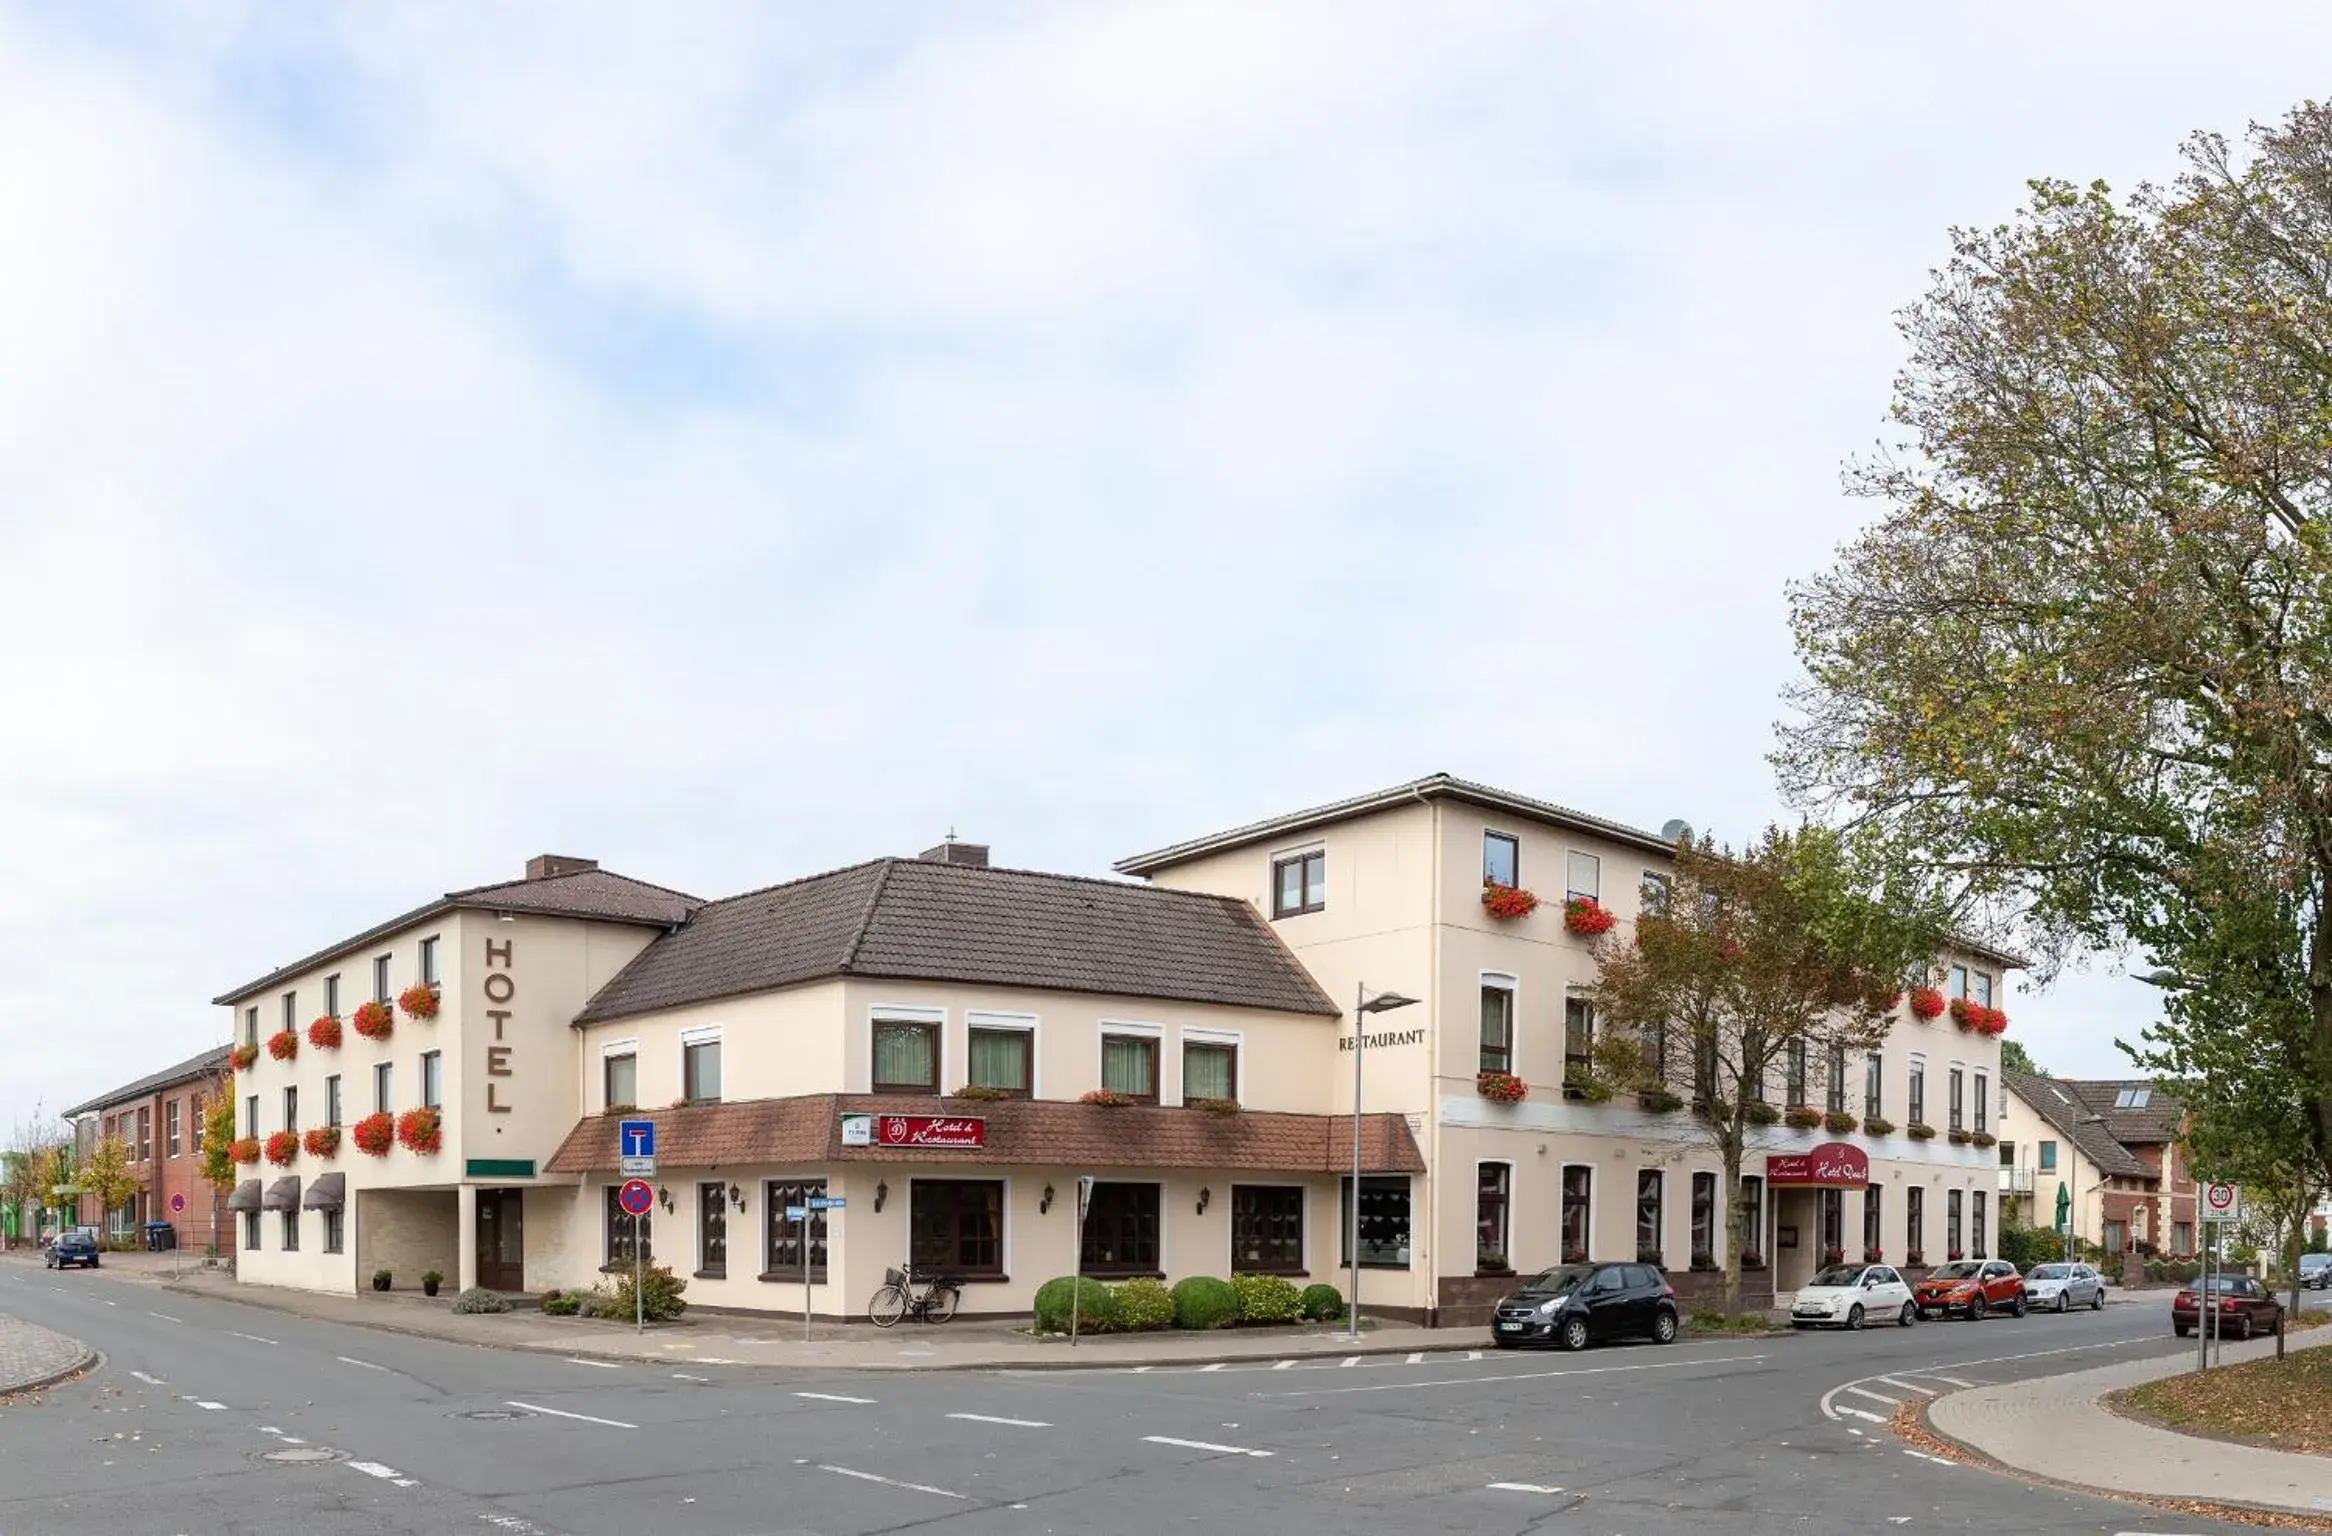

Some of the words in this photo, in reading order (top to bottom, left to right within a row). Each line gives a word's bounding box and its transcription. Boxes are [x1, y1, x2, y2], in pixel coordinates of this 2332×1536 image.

[484, 937, 515, 1114] HOTEL
[926, 1118, 963, 1132] Hotel
[910, 1129, 977, 1145] Restaurant
[1815, 1160, 1841, 1178] Hotel
[2213, 1188, 2228, 1202] 30
